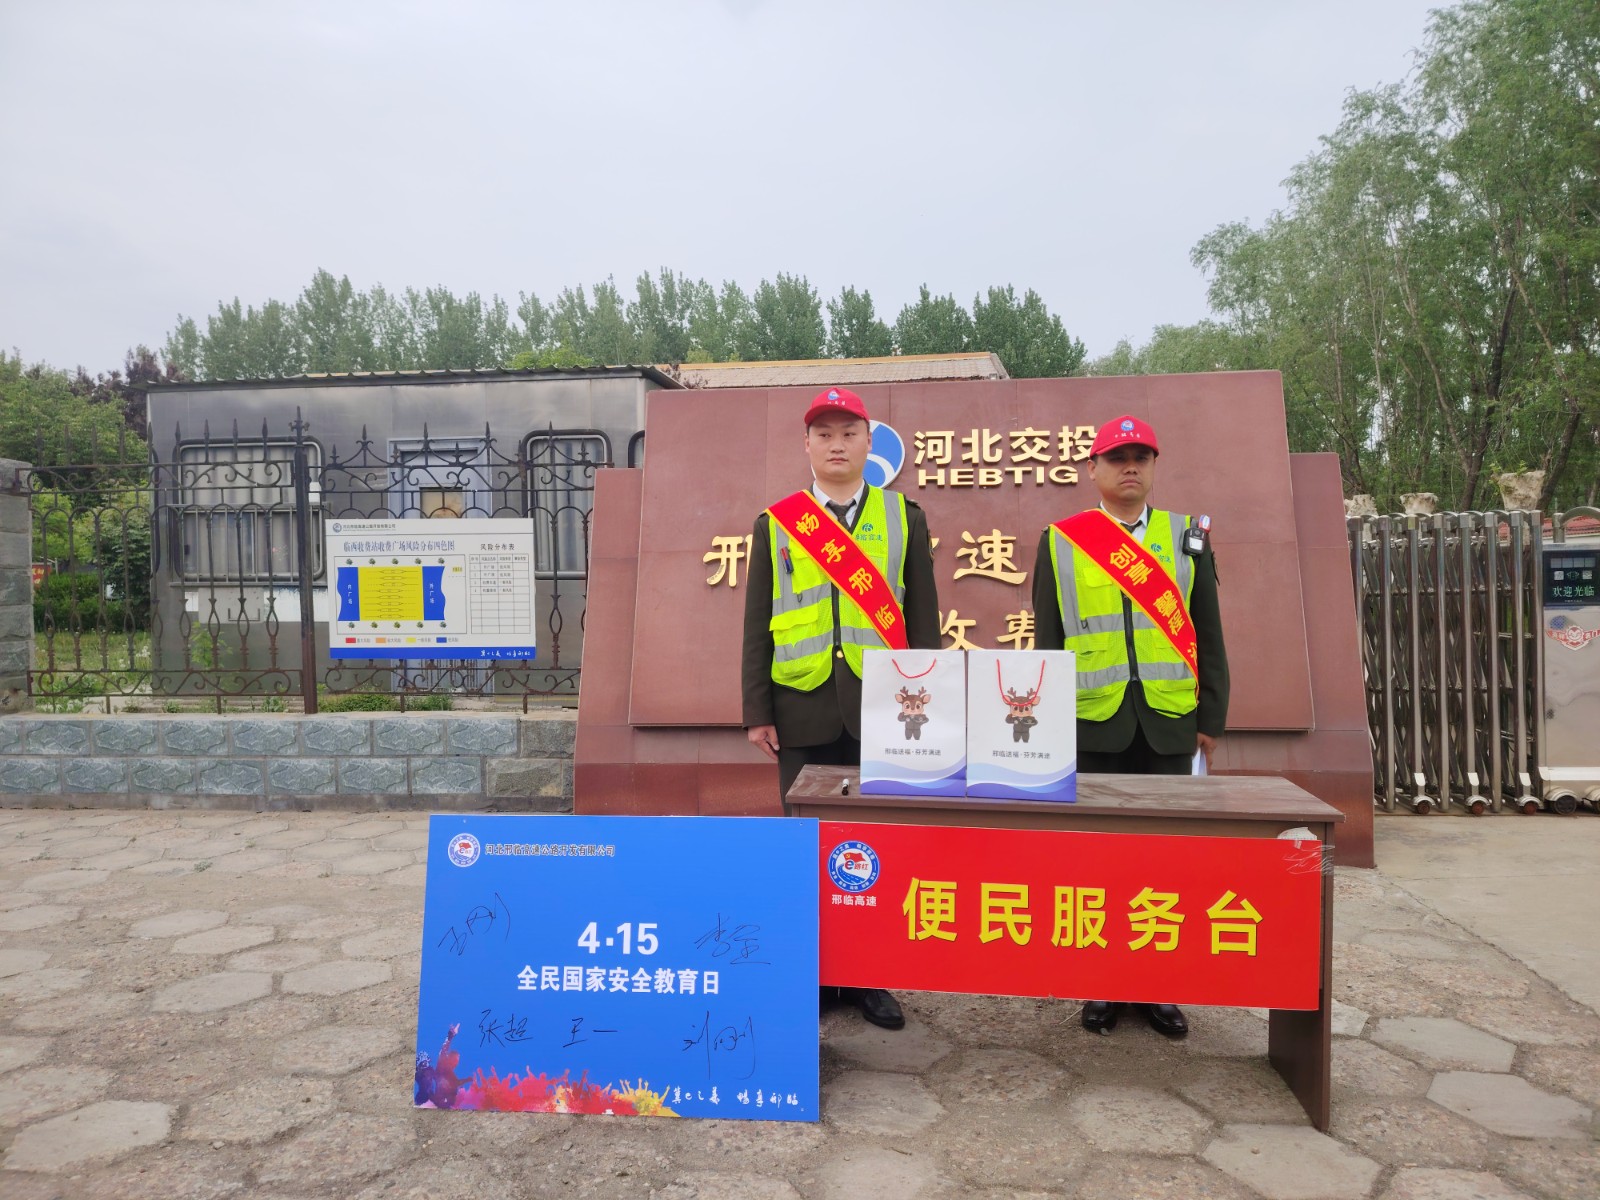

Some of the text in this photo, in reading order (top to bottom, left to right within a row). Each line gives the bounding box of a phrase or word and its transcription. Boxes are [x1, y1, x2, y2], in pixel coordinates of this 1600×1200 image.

[914, 426, 1097, 465] 河北交投
[918, 466, 1079, 487] HEBTIG
[343, 540, 456, 553] 临西收费站收费广场风险分布四色图
[480, 543, 515, 551] 风险分布表
[796, 512, 896, 631] 畅享邢临
[1552, 585, 1595, 598] 欢迎光临
[485, 843, 616, 858] 河北邢临高速公路开发有限公司
[831, 894, 877, 907] 邢临高速
[902, 877, 1264, 957] 便民服务台
[516, 964, 720, 995] 全民国家安全教育日
